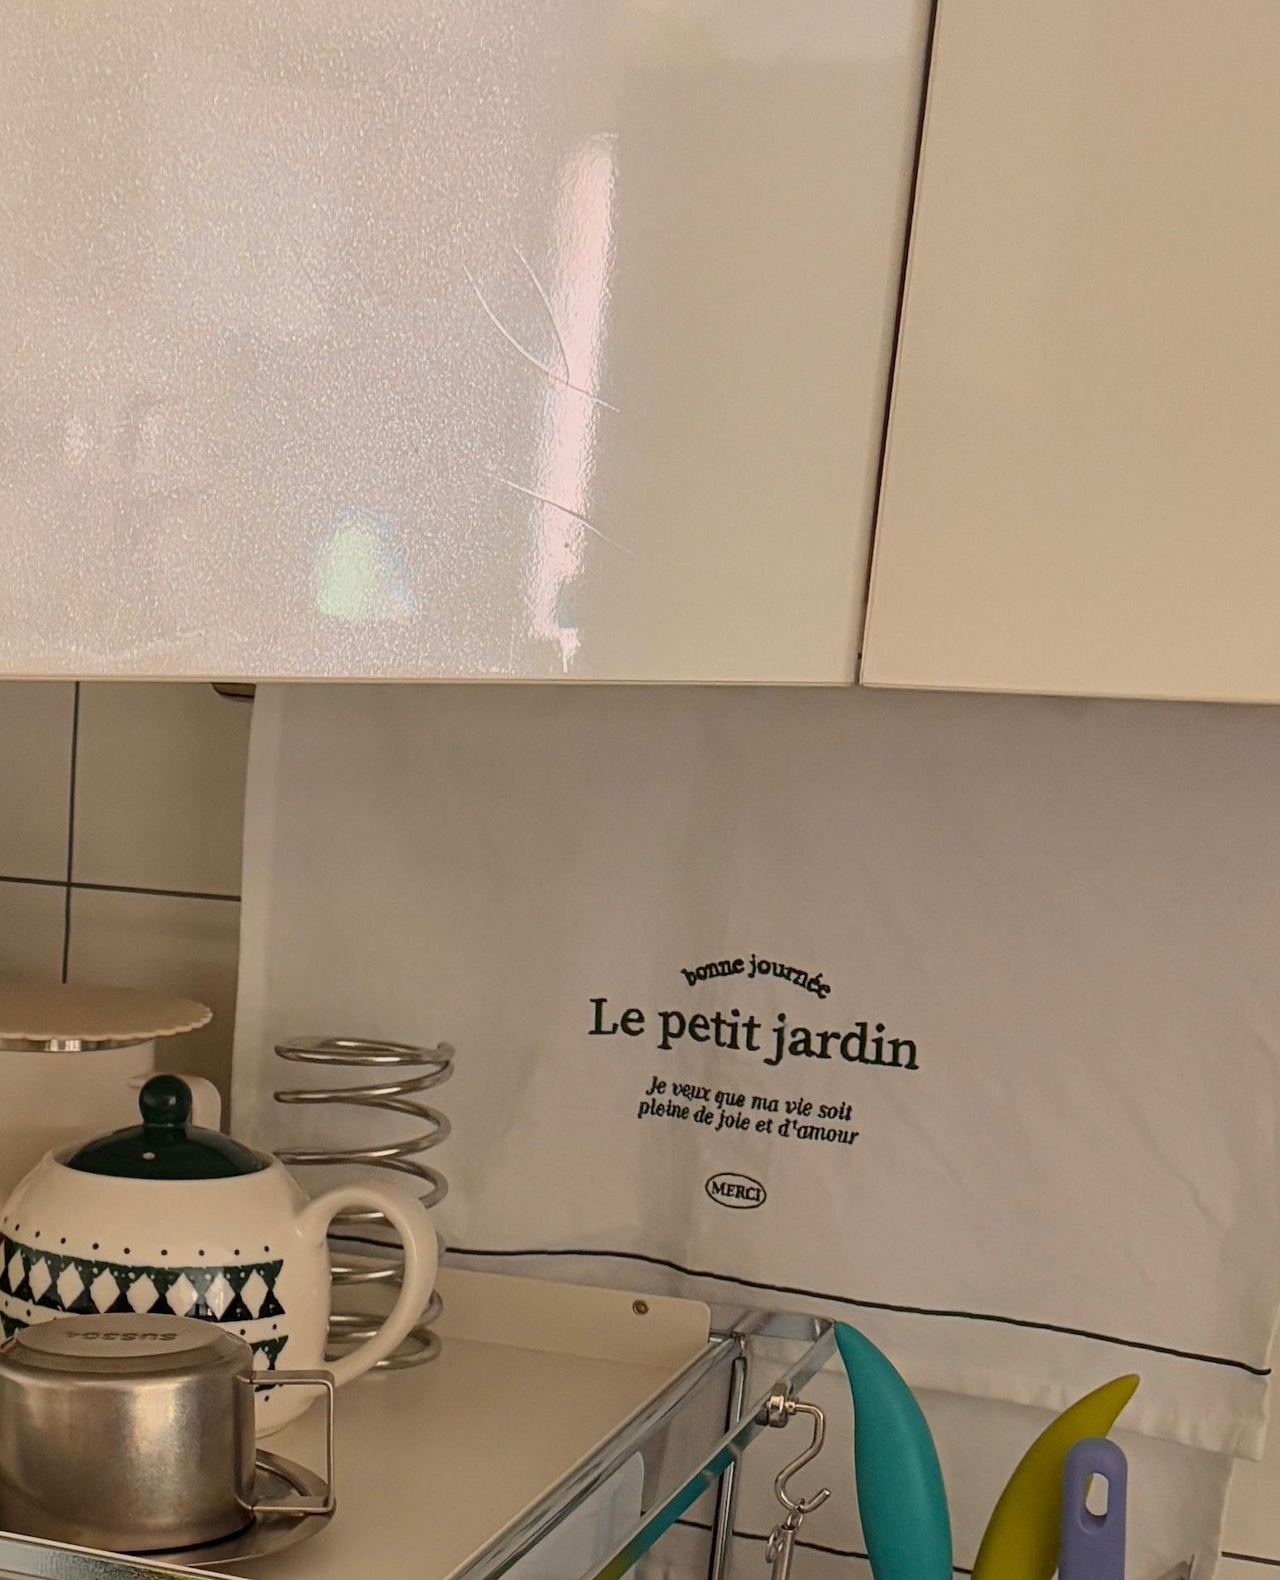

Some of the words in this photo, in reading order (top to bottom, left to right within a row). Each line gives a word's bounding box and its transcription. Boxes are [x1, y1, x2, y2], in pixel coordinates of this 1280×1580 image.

[681, 957, 745, 987] bonne
[747, 953, 832, 1000] journée
[588, 997, 645, 1036] Le
[657, 1007, 762, 1052] petit
[763, 1012, 920, 1070] jardin
[637, 1098, 690, 1119] pleine
[693, 1105, 714, 1125] de
[715, 1109, 751, 1132] joie
[755, 1118, 773, 1134] et
[778, 1118, 860, 1145] d'amour
[672, 1081, 710, 1101] veux
[714, 1089, 746, 1109] que
[750, 1094, 779, 1112] ma
[785, 1097, 813, 1117] vie
[817, 1101, 853, 1121] soit
[711, 1179, 762, 1202] MERCI
